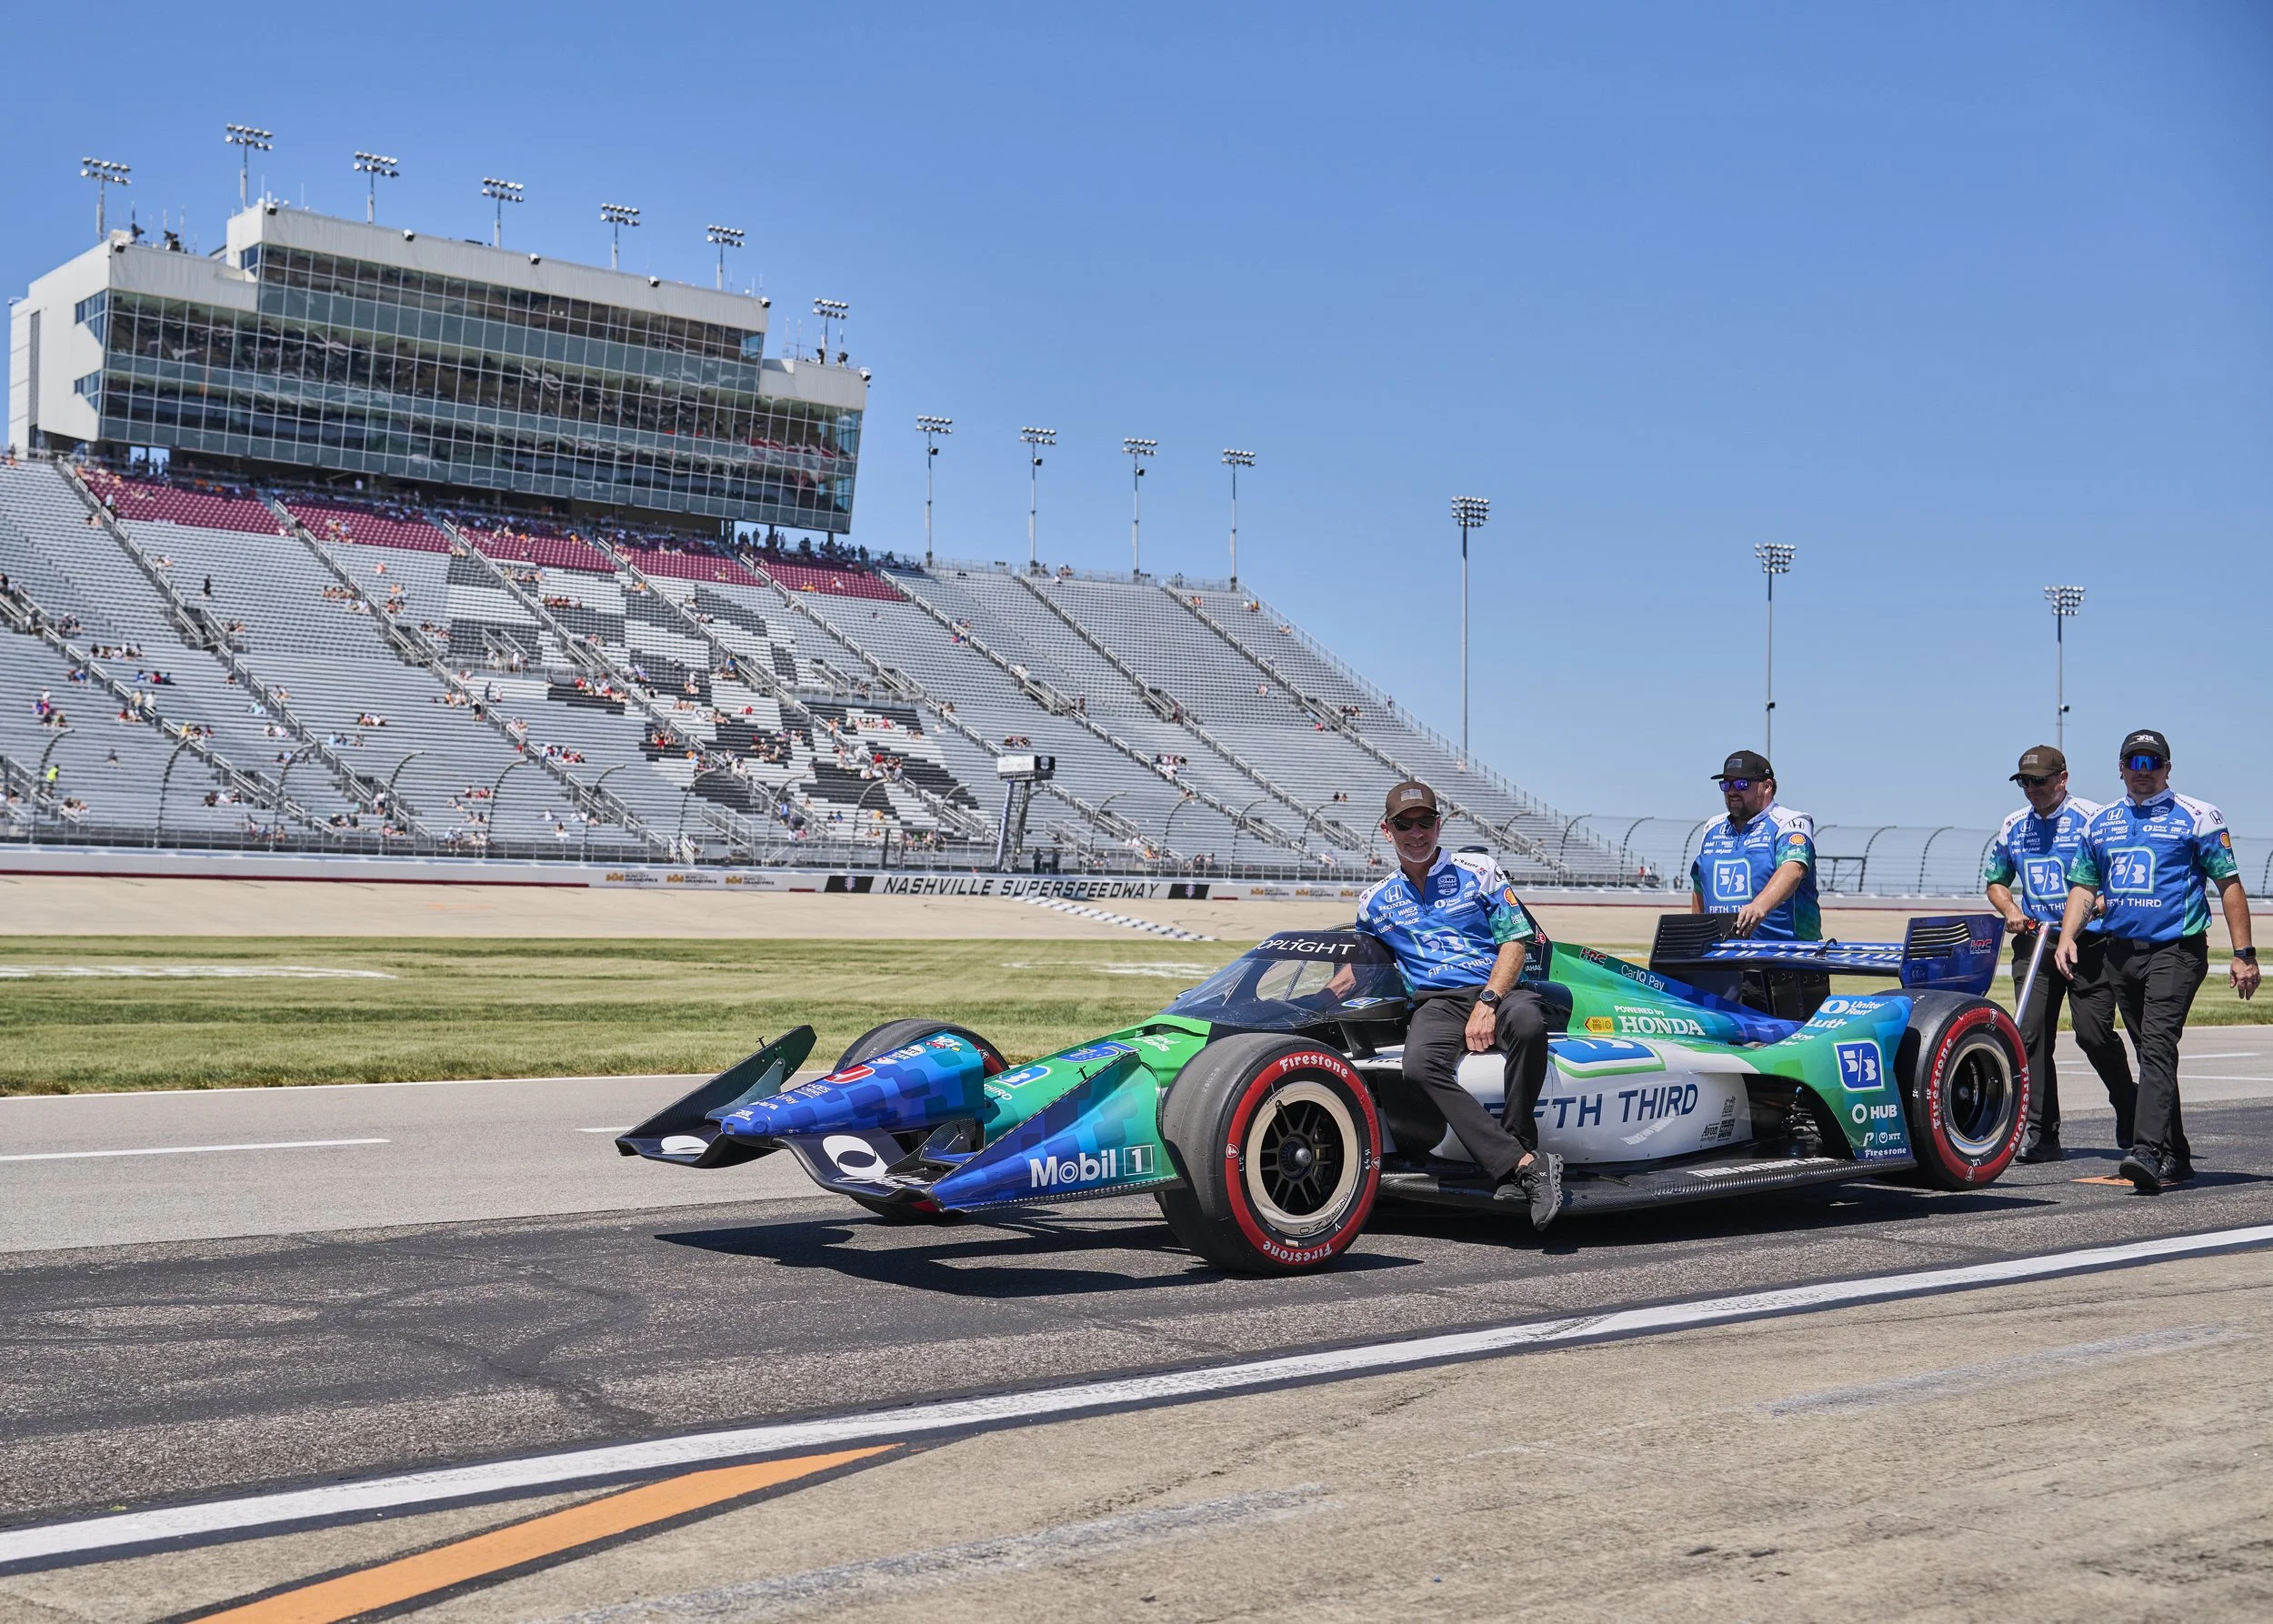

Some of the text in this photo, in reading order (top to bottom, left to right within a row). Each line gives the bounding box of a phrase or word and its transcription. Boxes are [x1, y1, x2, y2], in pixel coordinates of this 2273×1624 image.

[883, 876, 1160, 899] NASHVILLE SUPERSPEEDWAY
[1377, 898, 1413, 911] HONDA
[2128, 898, 2162, 907] THIRD
[1458, 957, 1493, 969] THIRD
[1647, 974, 1666, 991] Pay
[1614, 1005, 1665, 1017] POWERED by
[1617, 1015, 1706, 1036] HONDA
[1279, 1055, 1348, 1078] Firestone
[1932, 1038, 1953, 1129] Firestone
[1618, 1083, 1698, 1123] THIRD
[1870, 1104, 1898, 1119] HUB
[2008, 1063, 2029, 1152] Firestone
[1865, 1148, 1907, 1158] Firestone
[1029, 1148, 1142, 1188] Mobil 1
[1325, 1191, 1349, 1225] RACING
[1262, 1240, 1333, 1262] Firestone
